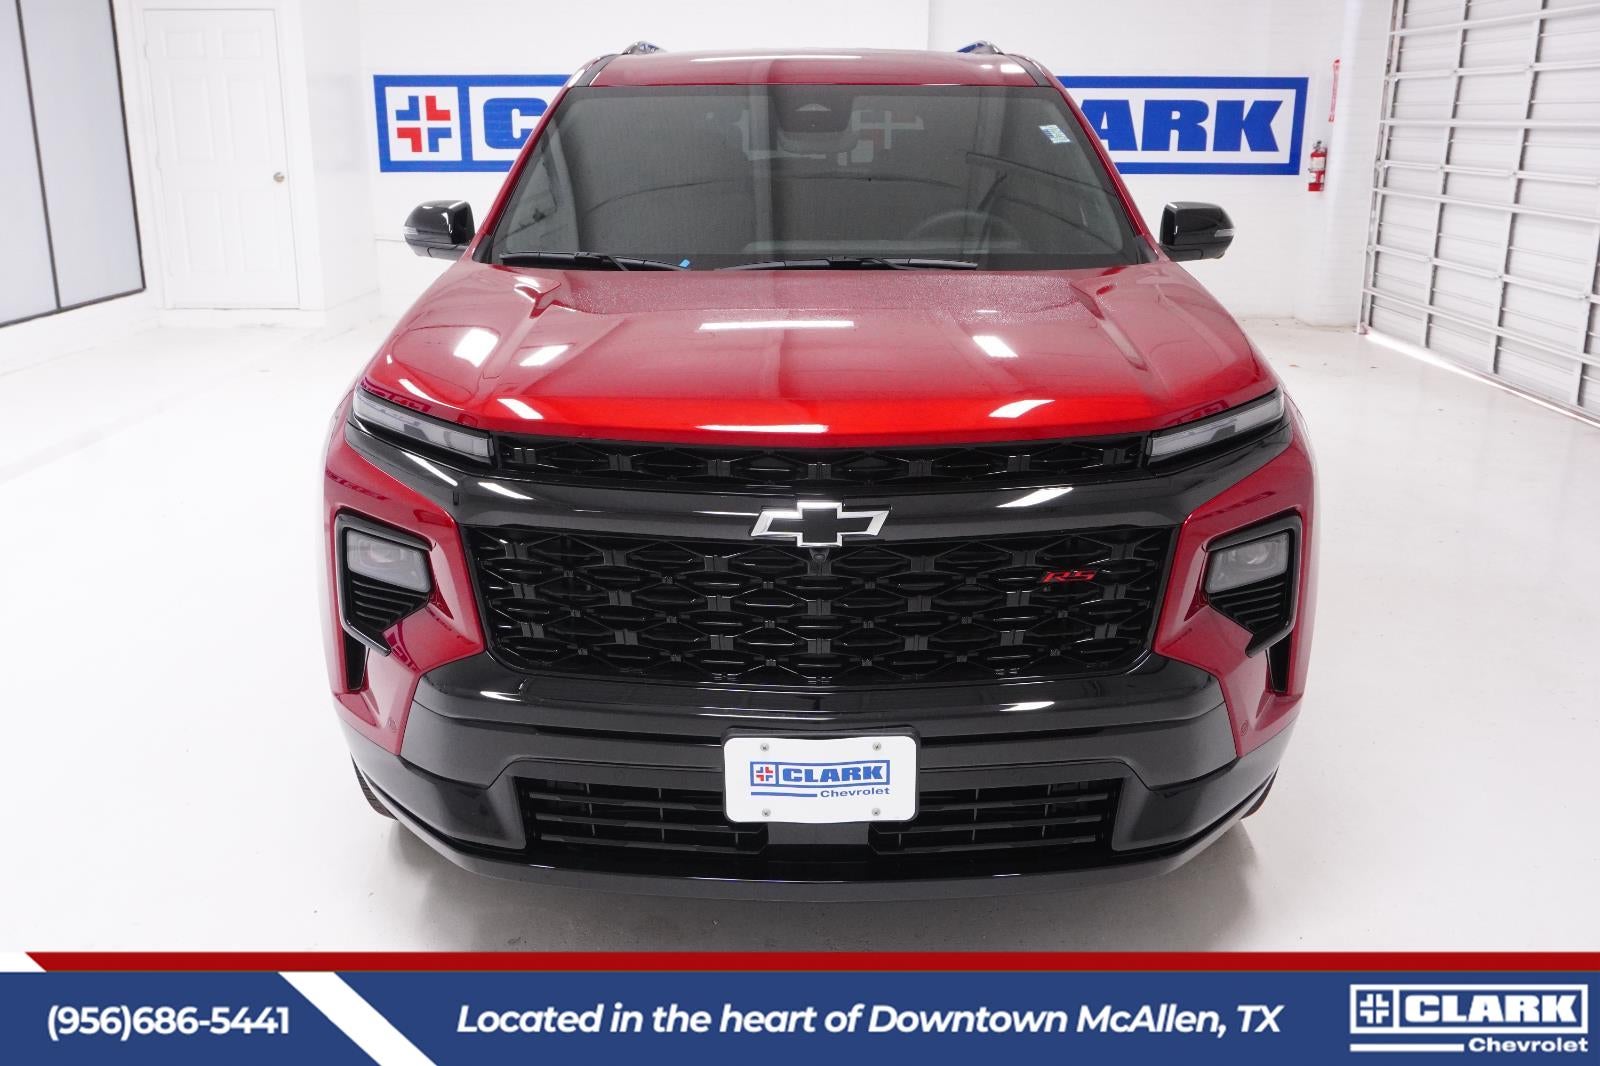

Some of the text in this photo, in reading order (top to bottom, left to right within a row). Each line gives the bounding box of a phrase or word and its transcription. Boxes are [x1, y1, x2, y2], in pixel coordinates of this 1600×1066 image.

[1041, 571, 1097, 583] RS
[782, 764, 883, 783] CLARK
[820, 787, 890, 798] Chevrolet
